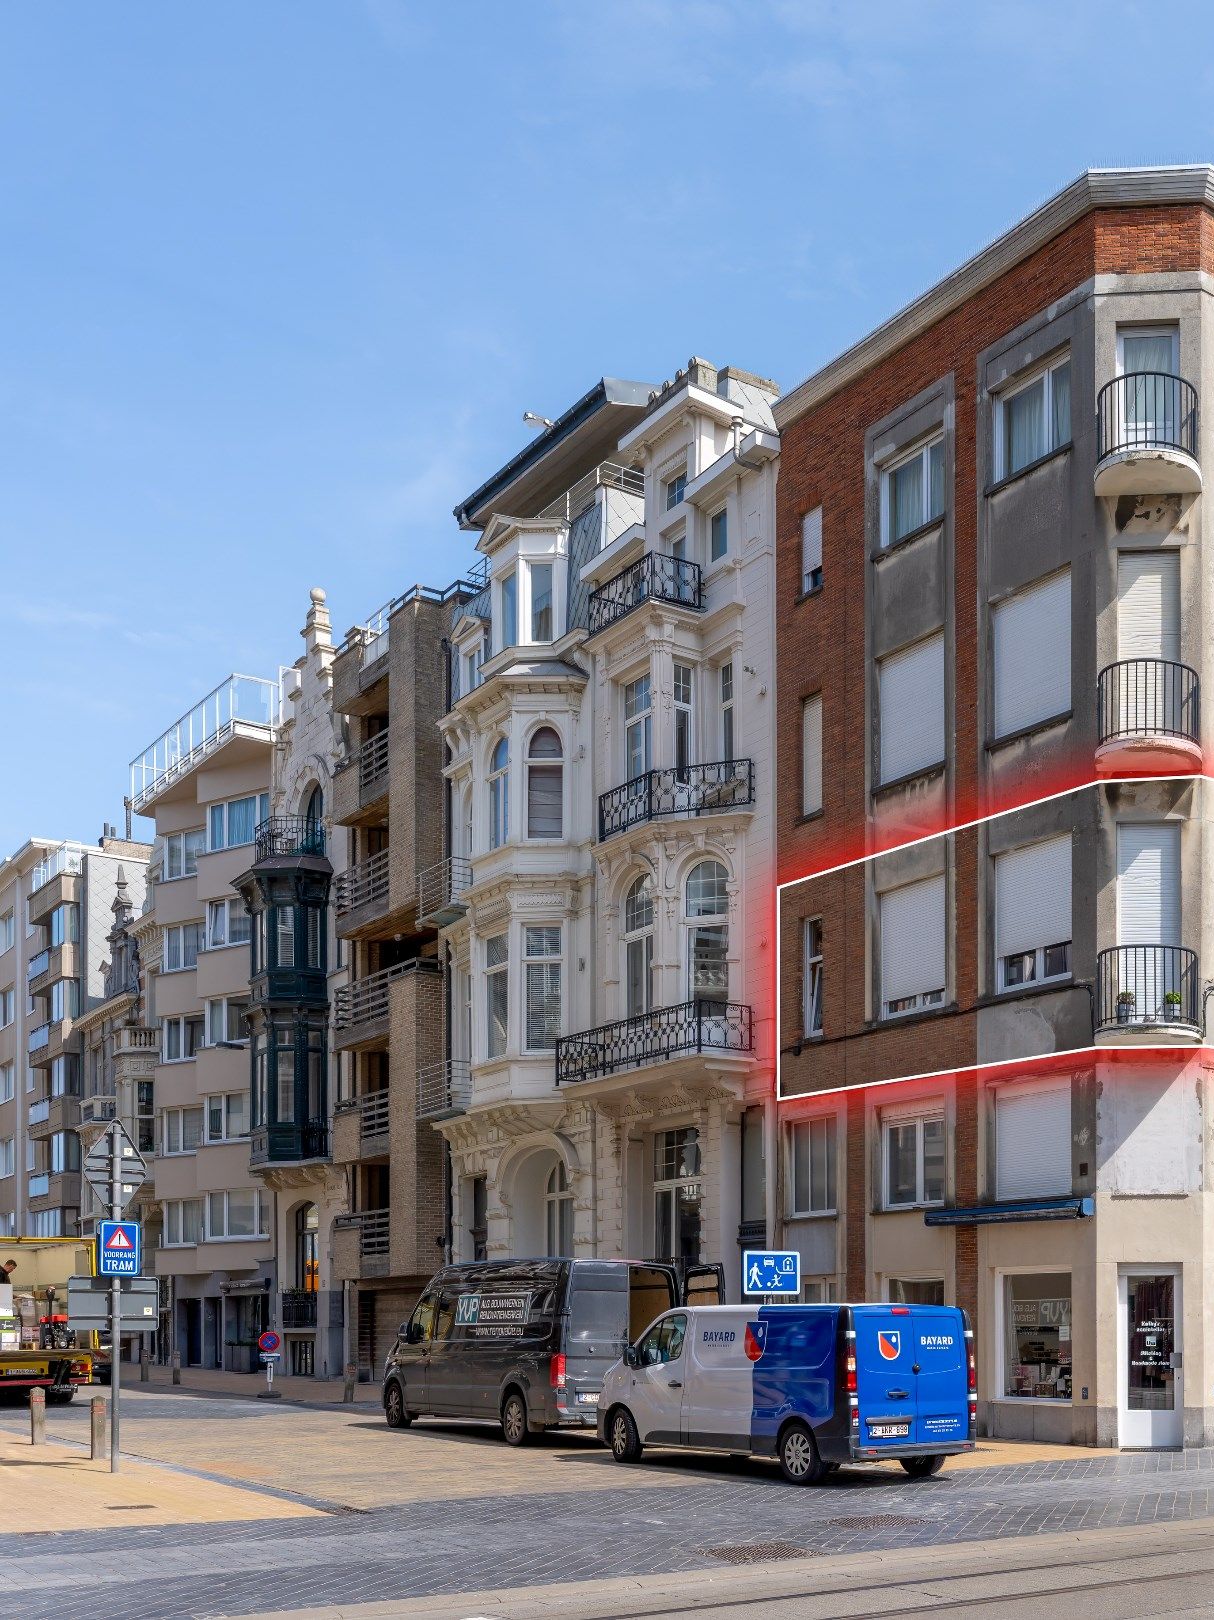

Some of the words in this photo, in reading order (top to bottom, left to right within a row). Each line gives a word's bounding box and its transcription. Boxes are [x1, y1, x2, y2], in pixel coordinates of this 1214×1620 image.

[104, 1251, 136, 1259] VOORRANG
[106, 1260, 133, 1271] TRAM
[703, 1331, 736, 1342] BAYARD
[920, 1336, 954, 1345] BAYARD
